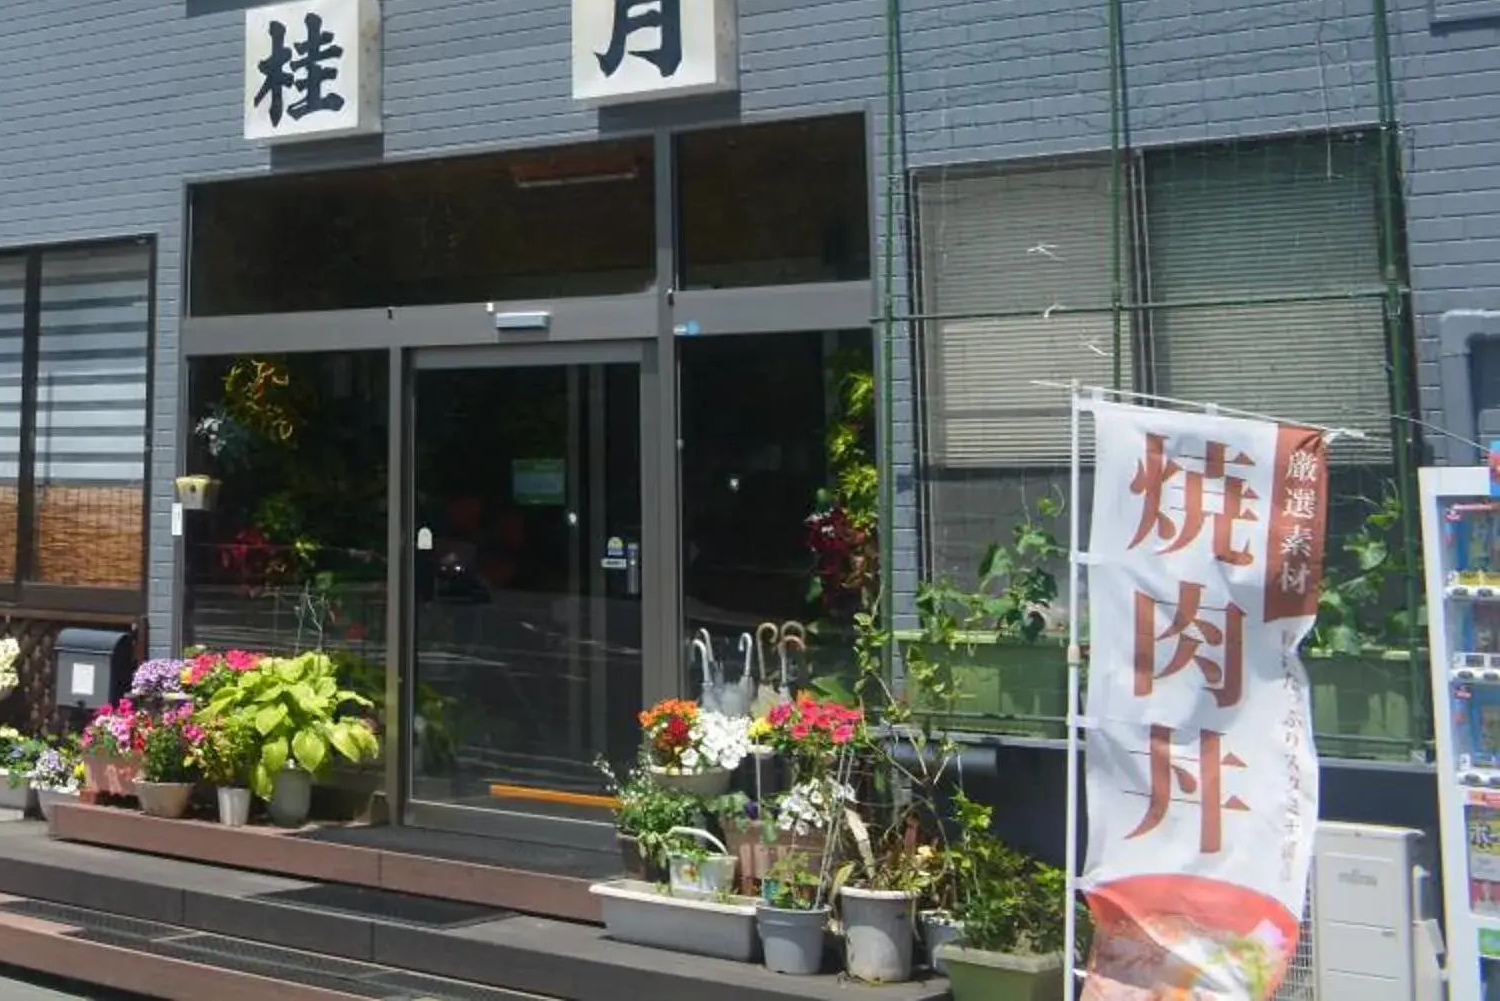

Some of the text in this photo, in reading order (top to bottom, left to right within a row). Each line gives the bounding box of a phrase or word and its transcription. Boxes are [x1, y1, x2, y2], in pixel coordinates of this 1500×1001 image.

[252, 10, 345, 129] 桂
[1123, 431, 1261, 854] 焼肉丼
